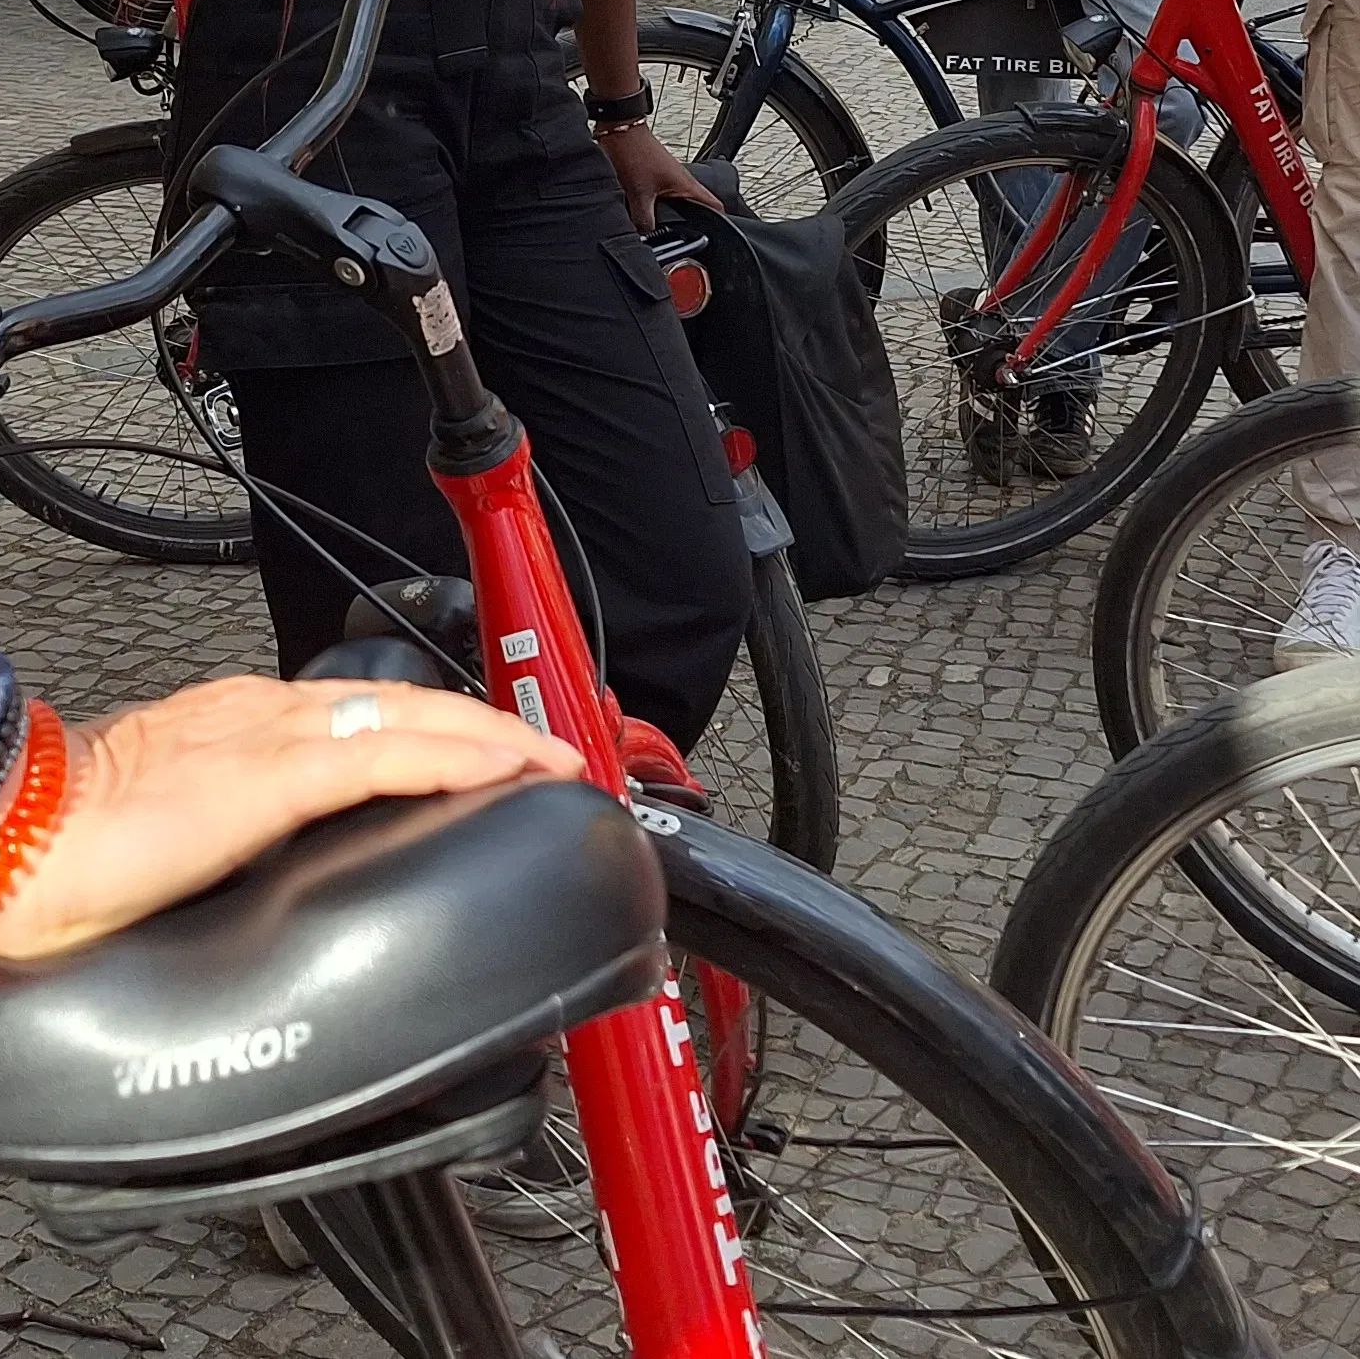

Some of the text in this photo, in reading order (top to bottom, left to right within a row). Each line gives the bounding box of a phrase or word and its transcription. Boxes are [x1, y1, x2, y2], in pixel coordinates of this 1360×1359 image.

[945, 55, 985, 70] FAT
[992, 56, 1040, 73] TIRE
[1249, 81, 1278, 123] FAT
[1268, 123, 1300, 177] TIRE
[505, 637, 534, 657] U27
[113, 1020, 312, 1099] WITTKOP
